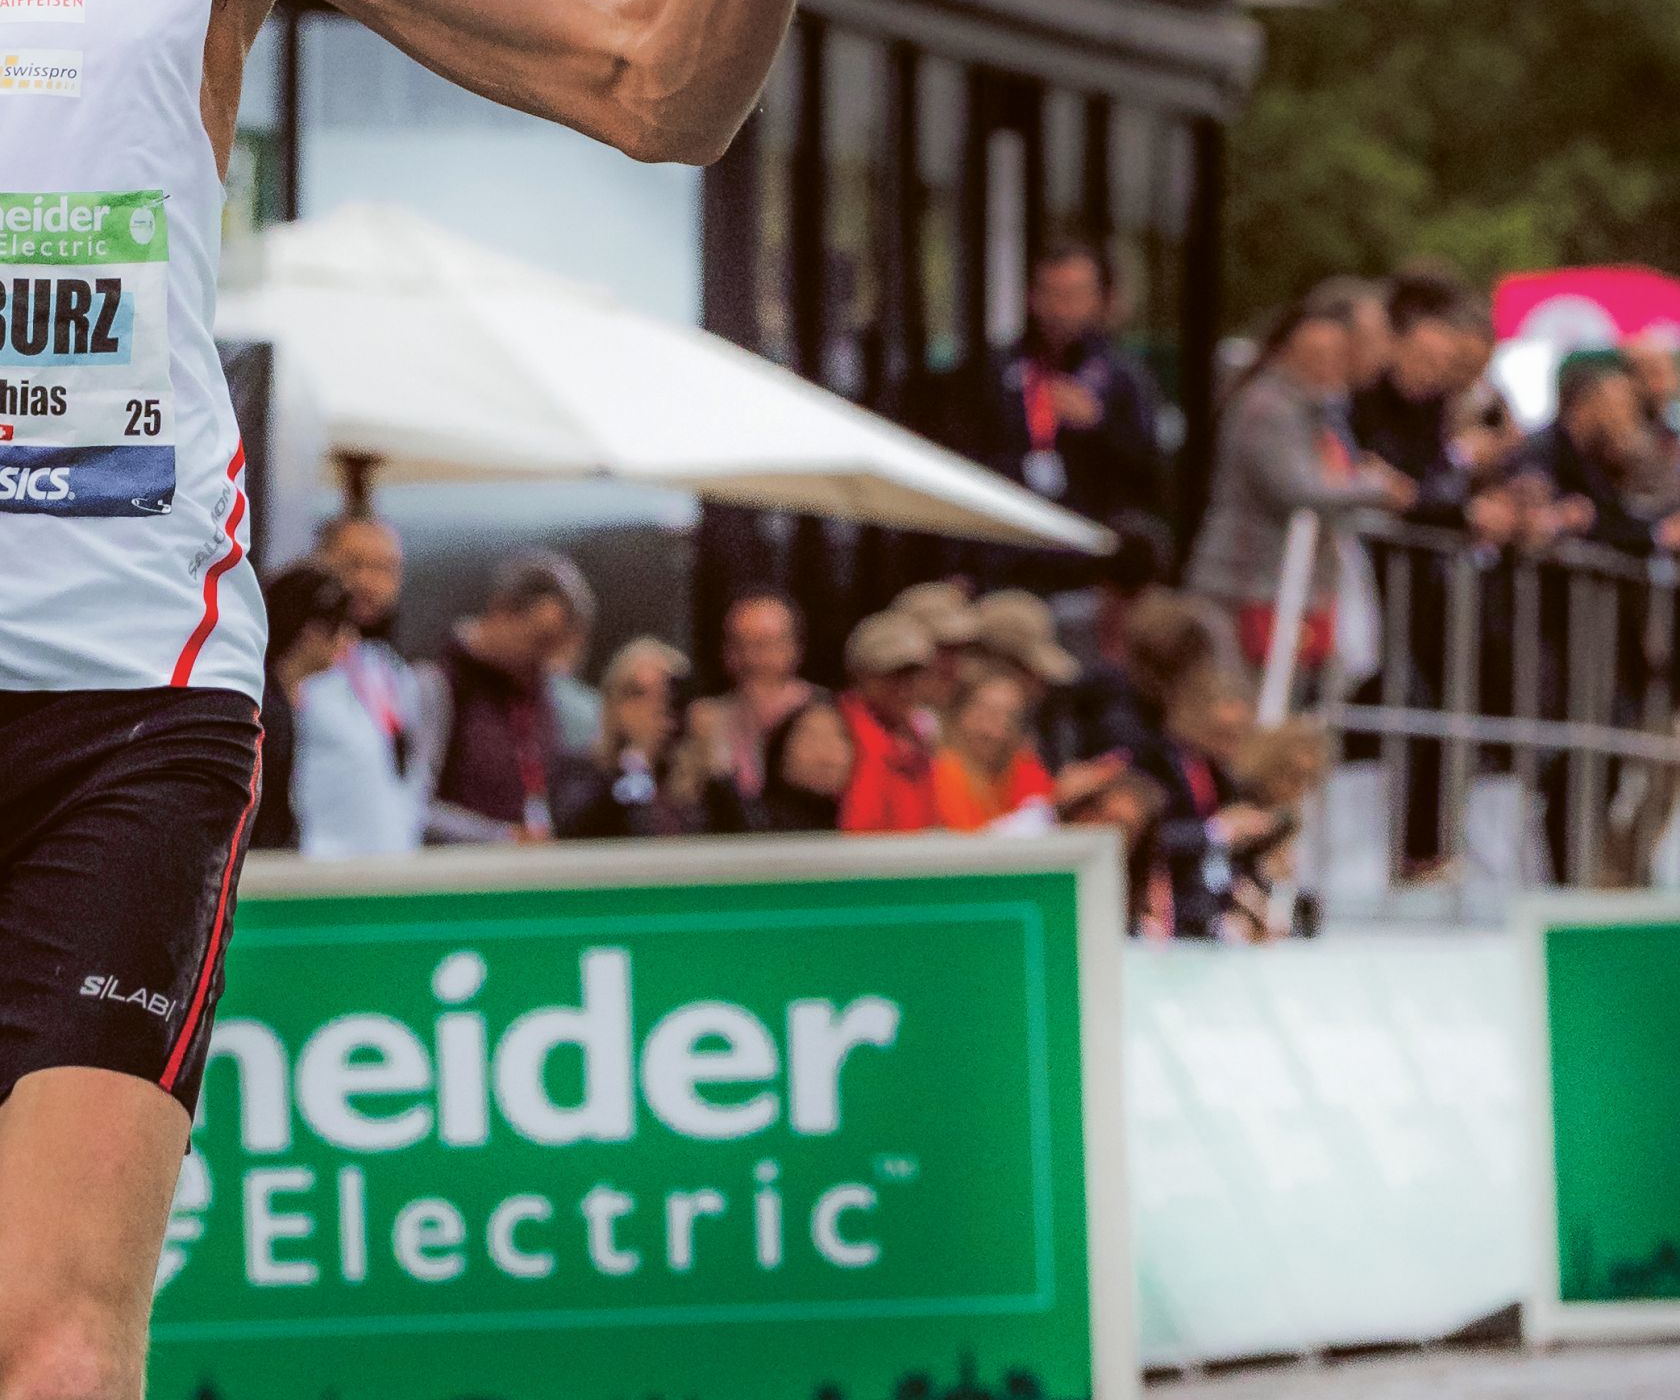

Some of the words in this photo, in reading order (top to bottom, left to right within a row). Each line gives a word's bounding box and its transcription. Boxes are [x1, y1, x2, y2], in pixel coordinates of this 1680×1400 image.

[4, 63, 78, 79] swisspro
[123, 399, 162, 437] 25
[190, 946, 900, 1154] neider
[242, 1160, 882, 1287] Electric
